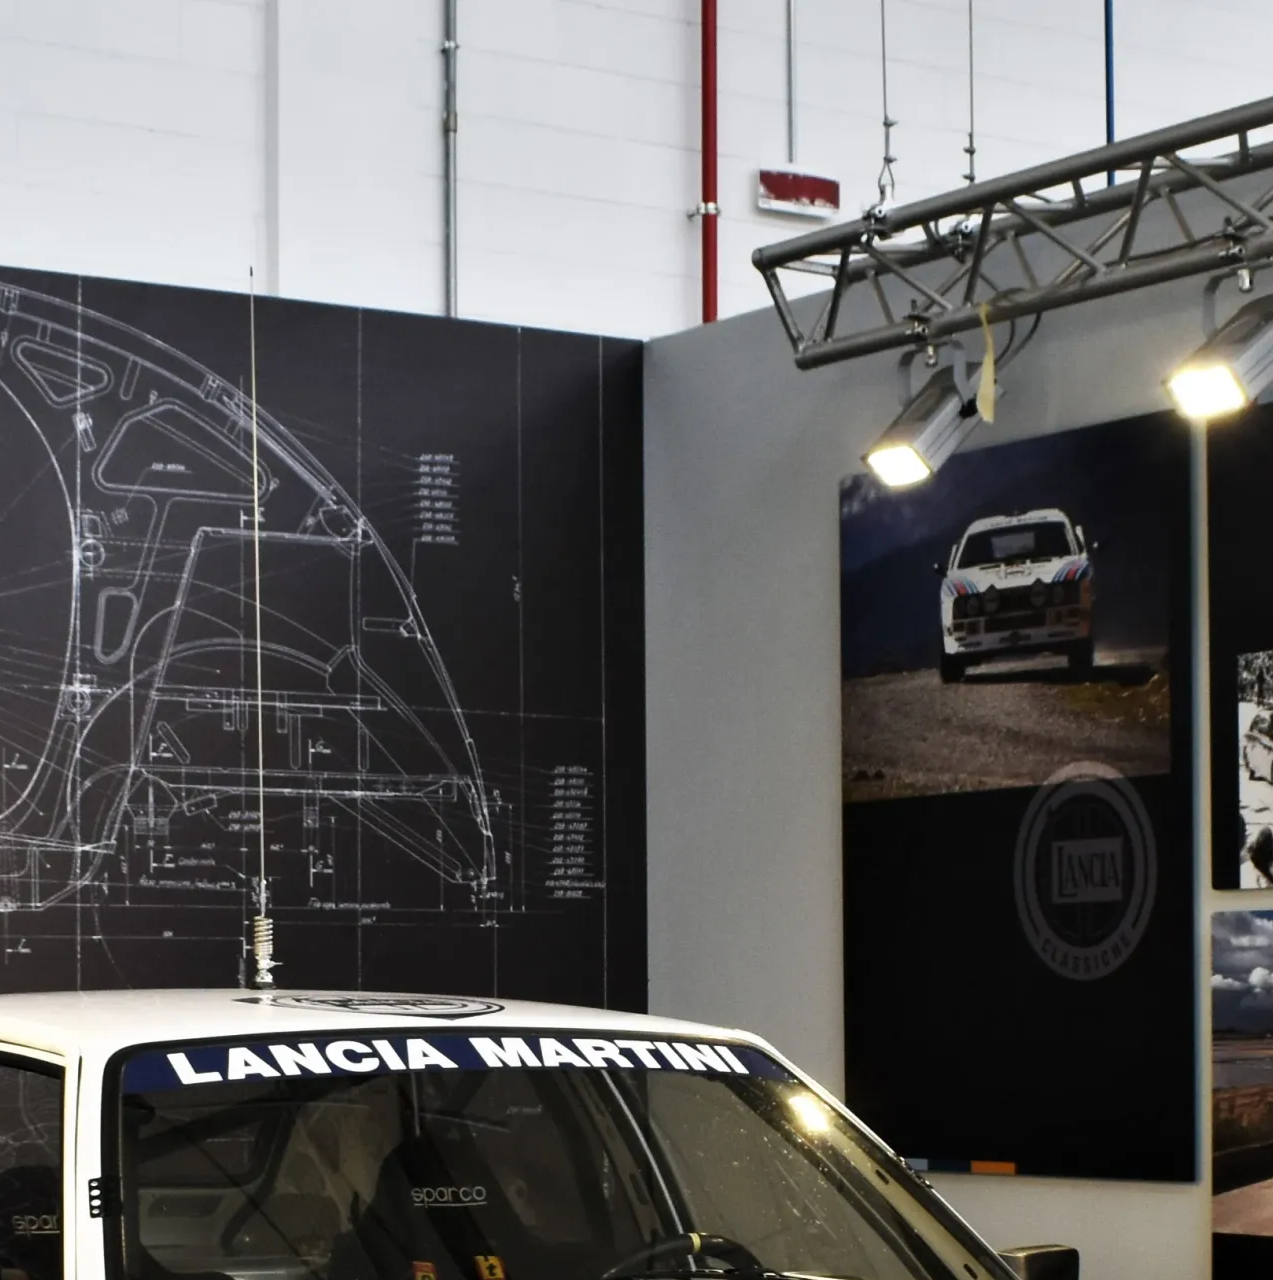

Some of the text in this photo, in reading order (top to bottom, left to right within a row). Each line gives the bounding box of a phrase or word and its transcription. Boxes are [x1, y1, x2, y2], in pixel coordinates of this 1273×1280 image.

[1057, 846, 1120, 898] LANCIA
[167, 1037, 750, 1085] LANCIA MARTINI
[411, 1186, 487, 1208] sparco
[12, 1214, 59, 1239] spar
